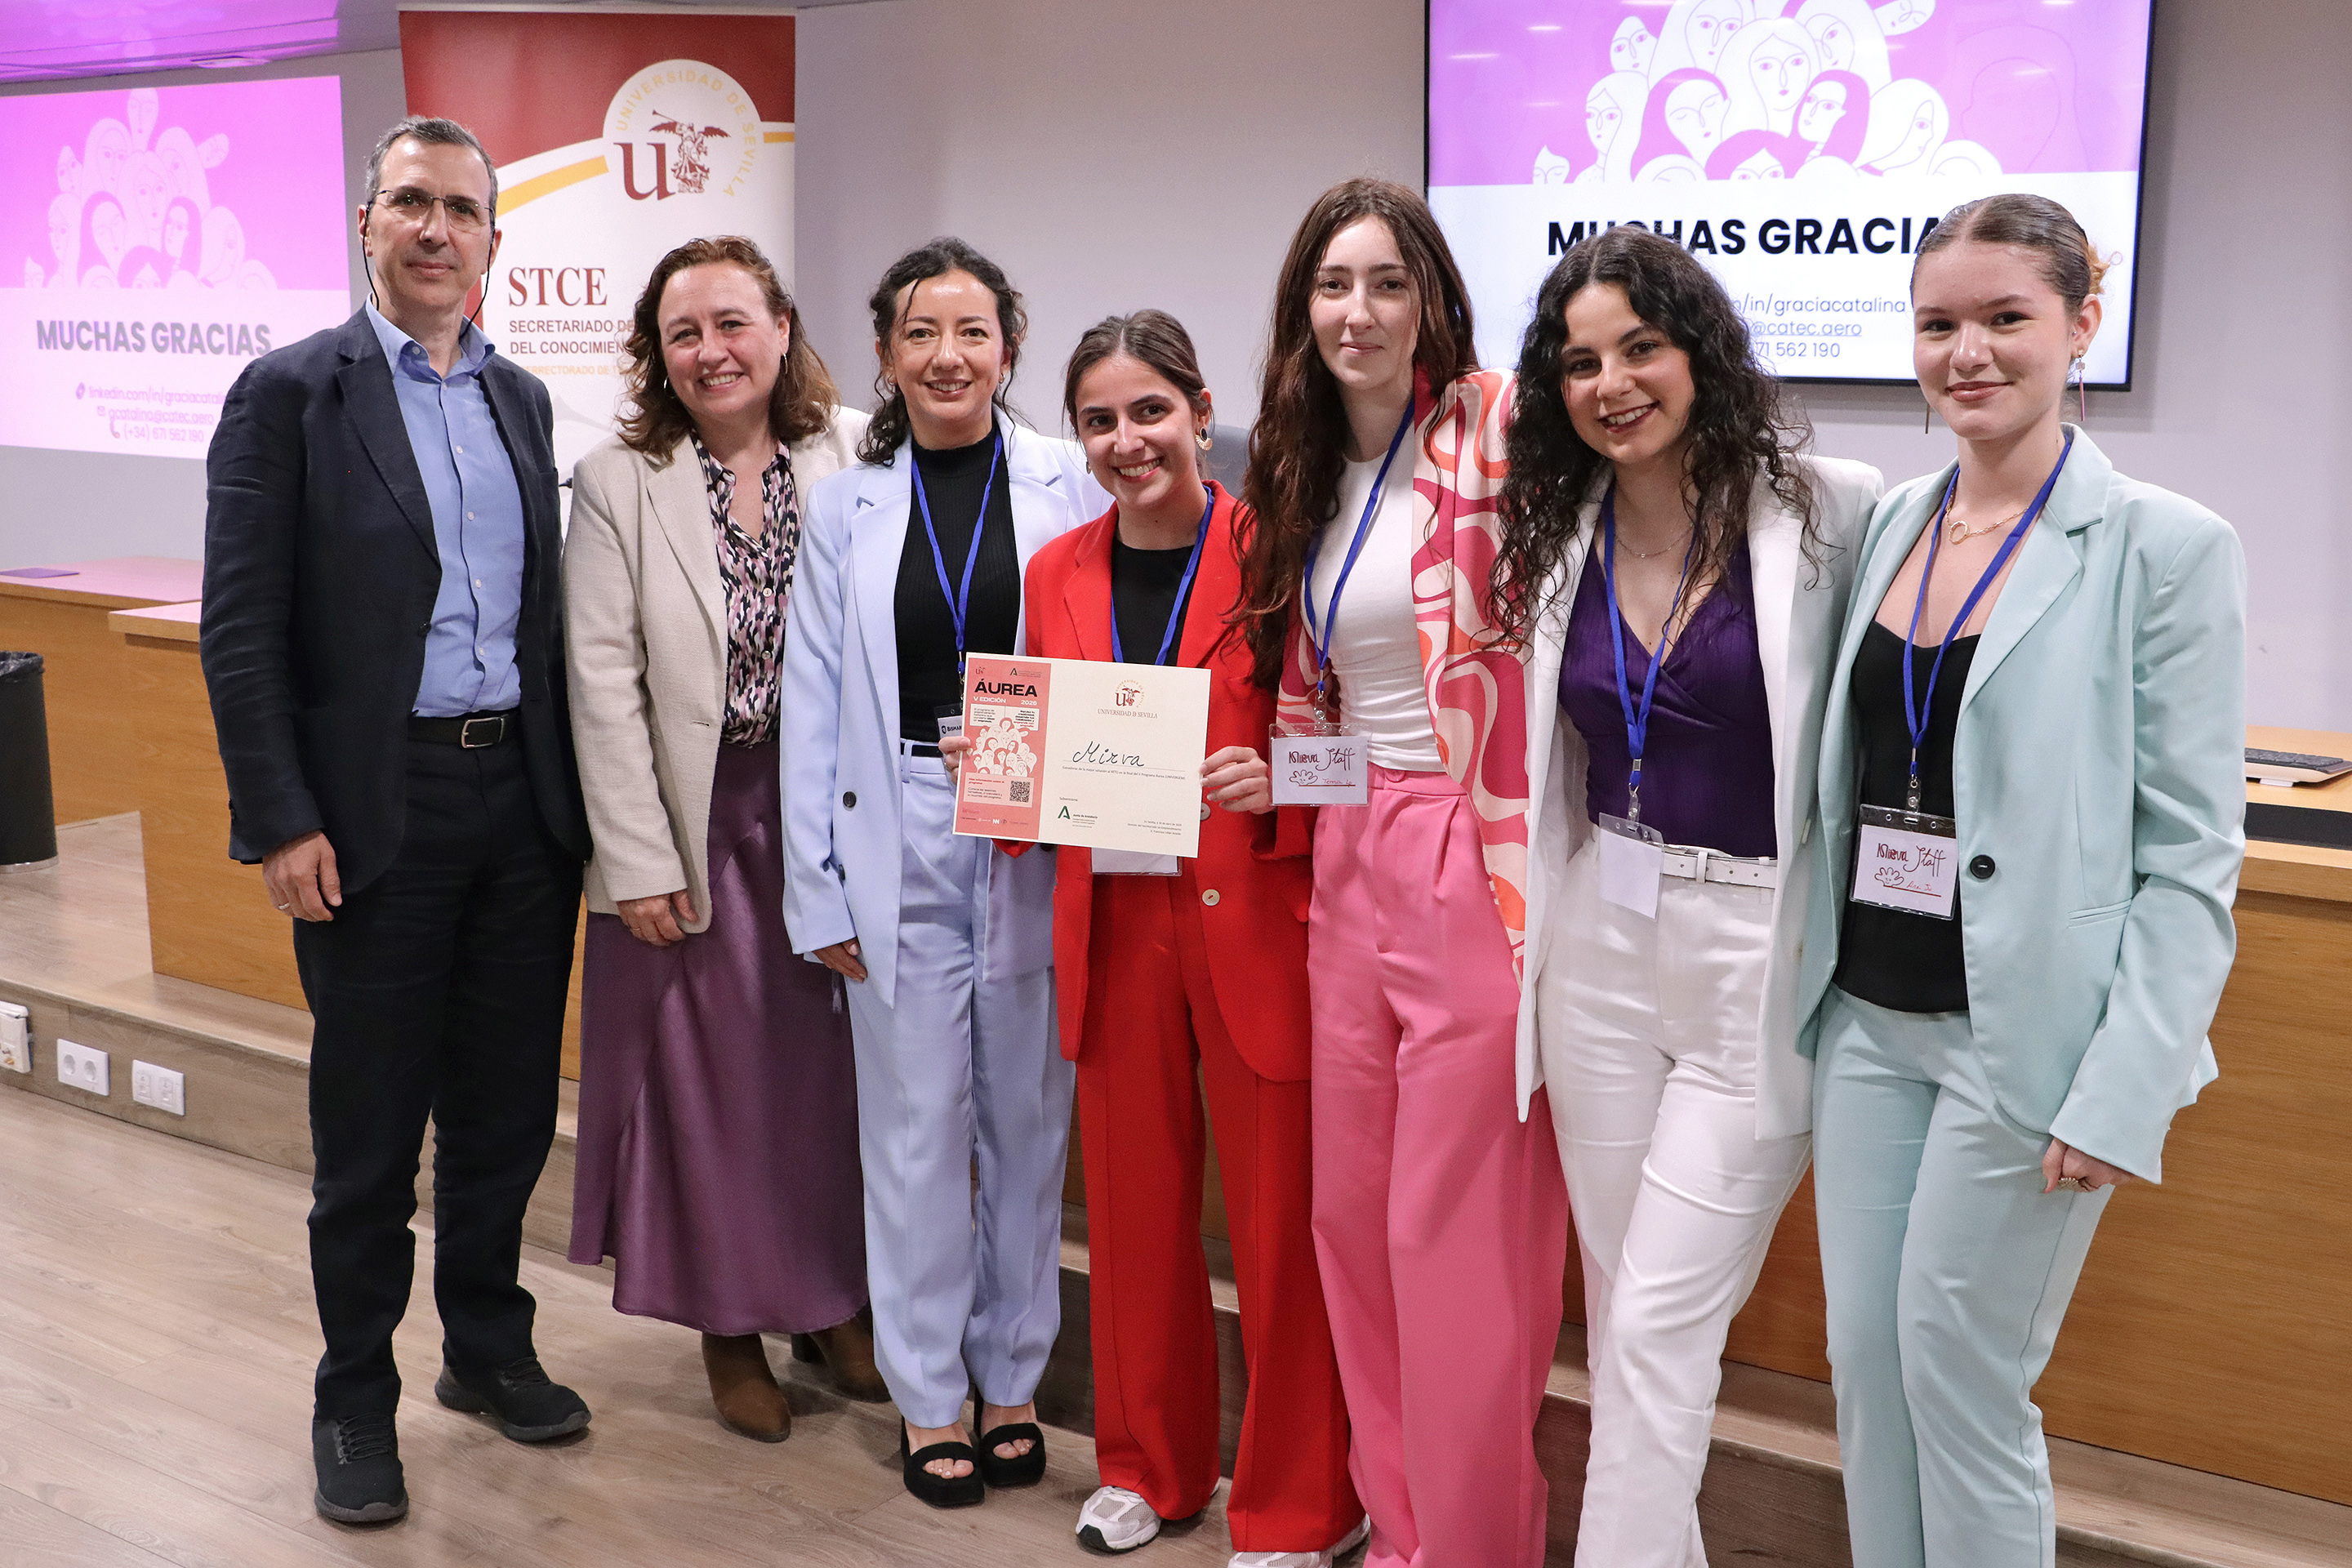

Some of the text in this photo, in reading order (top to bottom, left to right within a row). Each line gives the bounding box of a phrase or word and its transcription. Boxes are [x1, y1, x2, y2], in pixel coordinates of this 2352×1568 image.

[616, 70, 756, 196] UNIVERSIDAD DE SEVILLA
[509, 267, 608, 306] STCE
[510, 320, 612, 332] SECRETARIADO
[37, 320, 272, 355] MUCHAS GRACIAS
[510, 342, 536, 354] DEL
[1776, 342, 1806, 357] 562
[1813, 343, 1840, 358] 190
[124, 423, 150, 442] (+34)
[169, 428, 187, 442] 562
[189, 430, 204, 443] 190
[974, 678, 1038, 697] ÁUREA
[979, 696, 1007, 704] EDICIÓN
[1098, 708, 1132, 717] UNIVERSIDAD
[1072, 741, 1145, 767] Mirva
[1316, 747, 1356, 772] Staff
[1903, 845, 1947, 877] Staff
